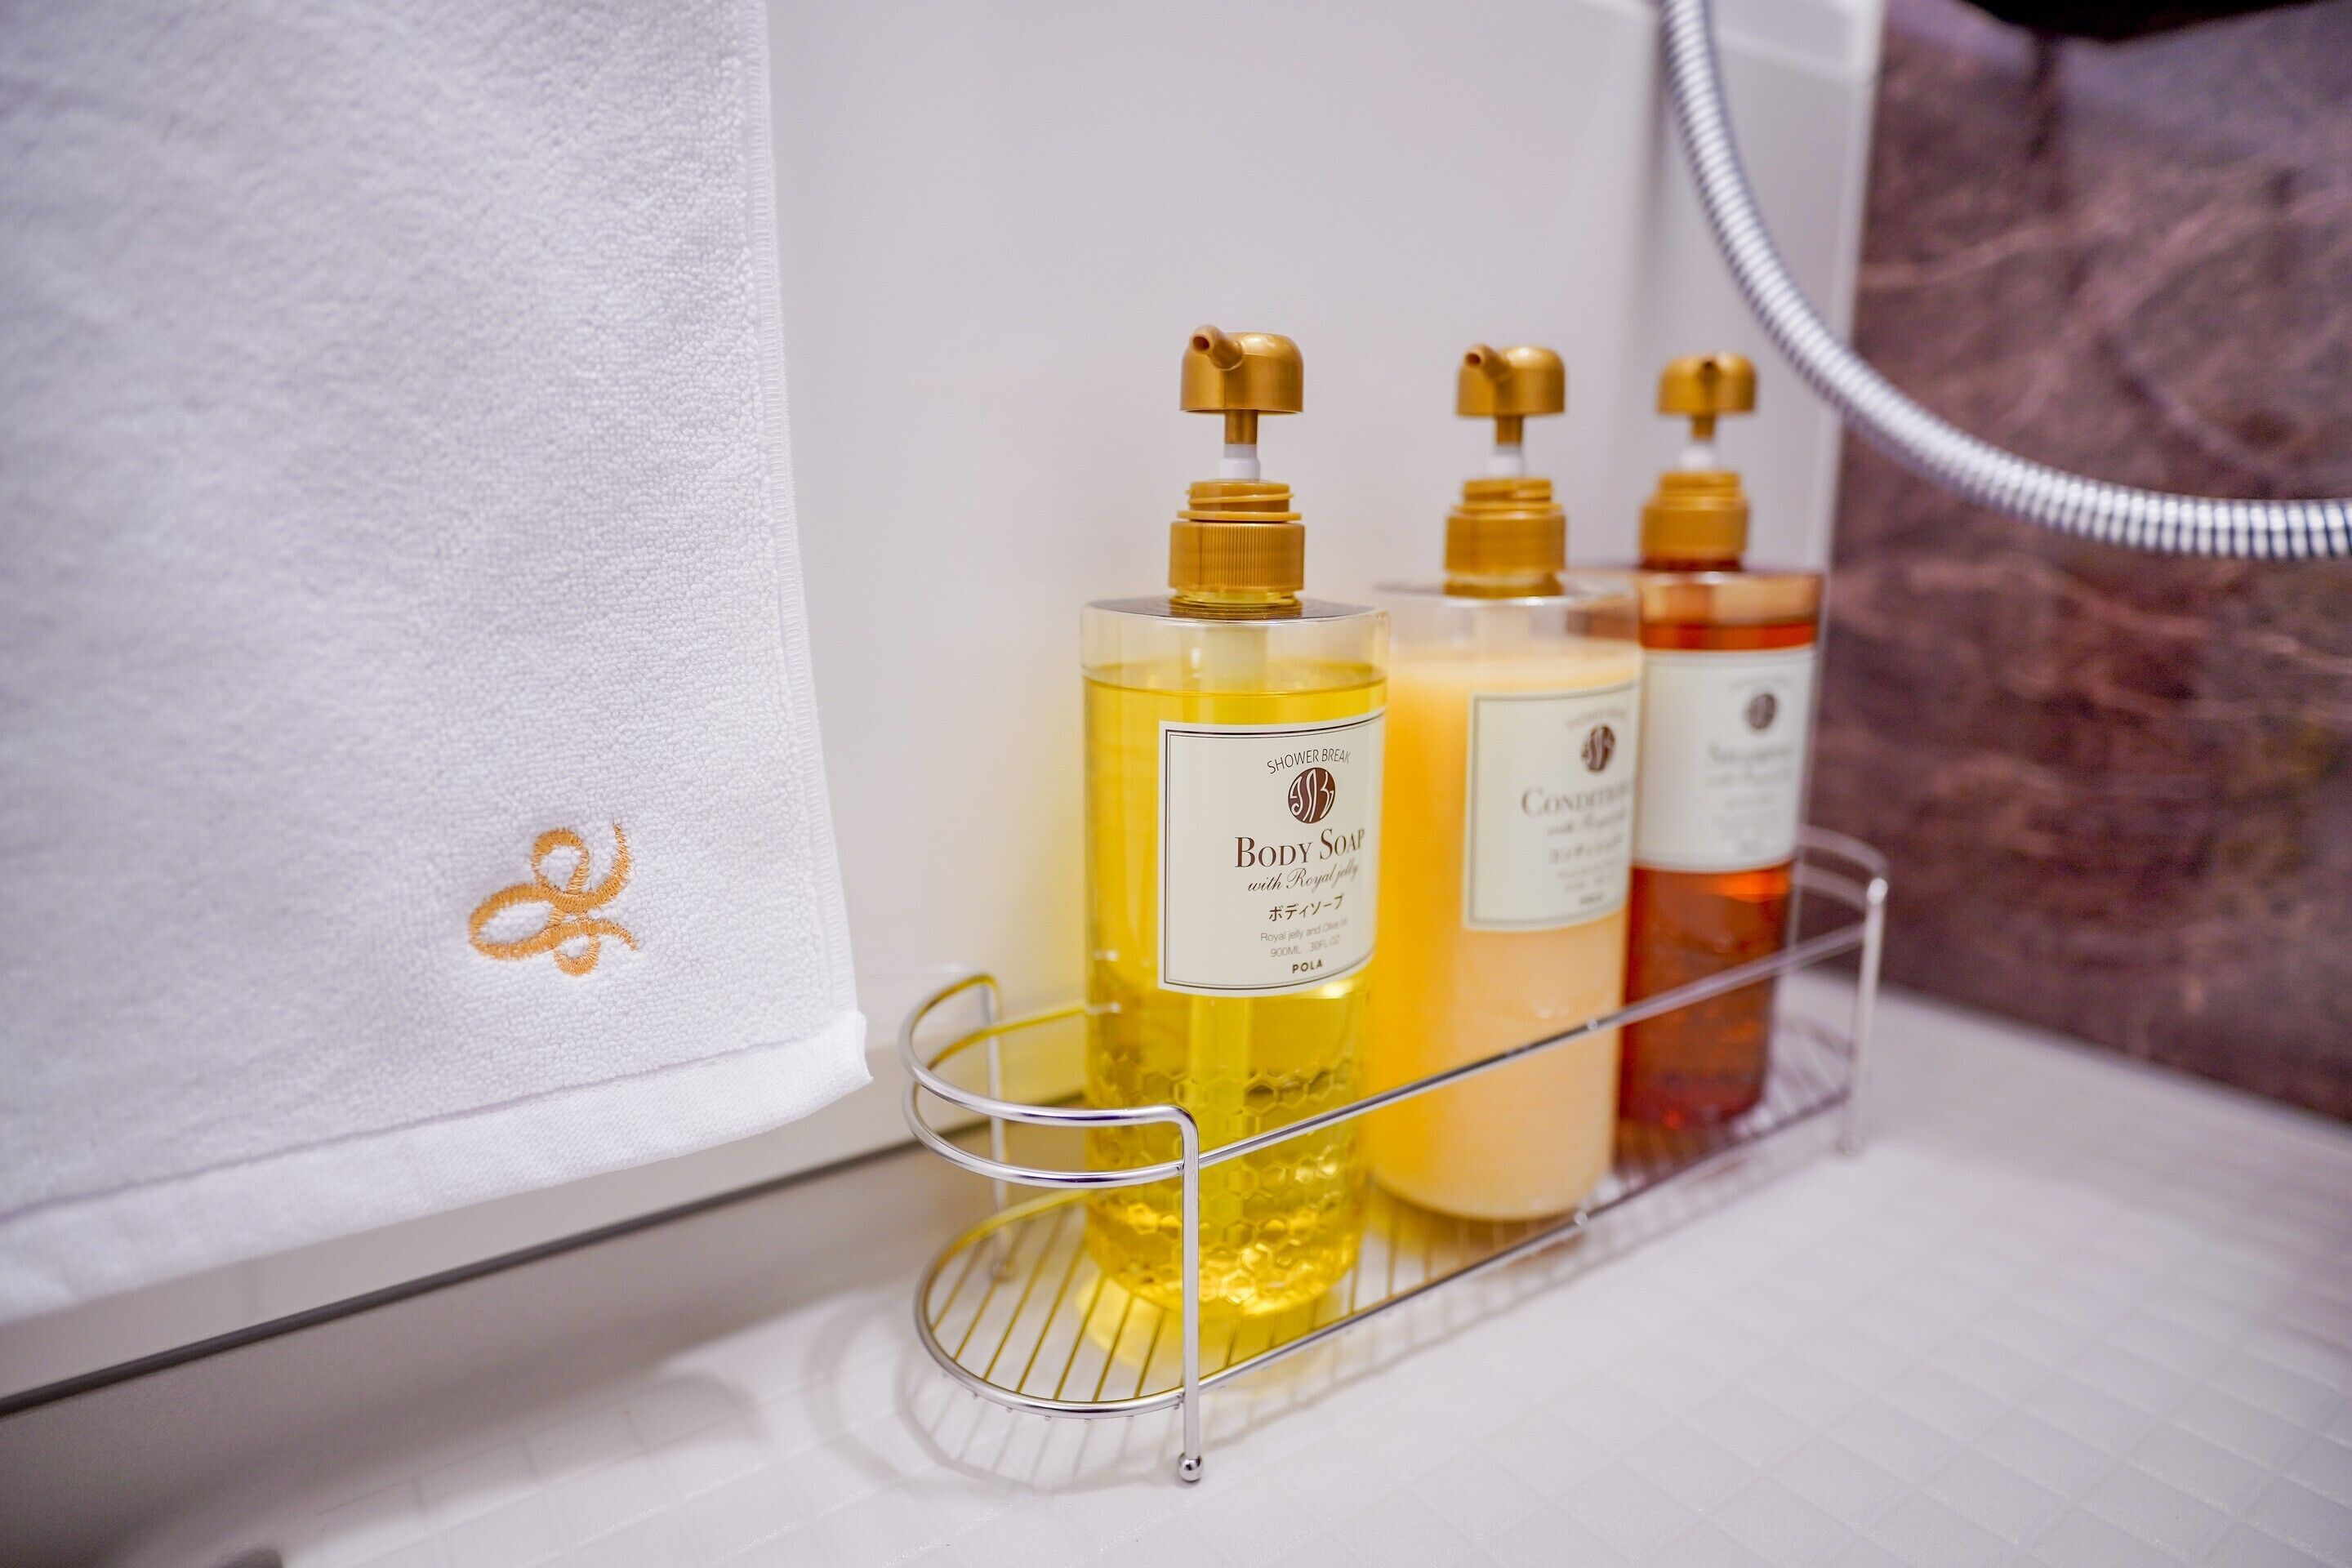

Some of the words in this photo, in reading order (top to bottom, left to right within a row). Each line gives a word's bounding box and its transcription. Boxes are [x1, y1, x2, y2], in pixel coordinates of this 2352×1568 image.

[1267, 749, 1319, 774] SHOWER
[1321, 748, 1352, 764] BREAK
[1235, 836, 1313, 868] BODY
[1320, 828, 1365, 860] SOAP
[1248, 872, 1283, 892] with
[1286, 862, 1337, 894] Royal
[1334, 858, 1360, 889] jelly
[1260, 931, 1286, 944] Royal
[1288, 928, 1304, 942] jelly
[1306, 925, 1321, 937] and
[1270, 945, 1302, 958] 900ML
[1292, 958, 1323, 974] POLA
